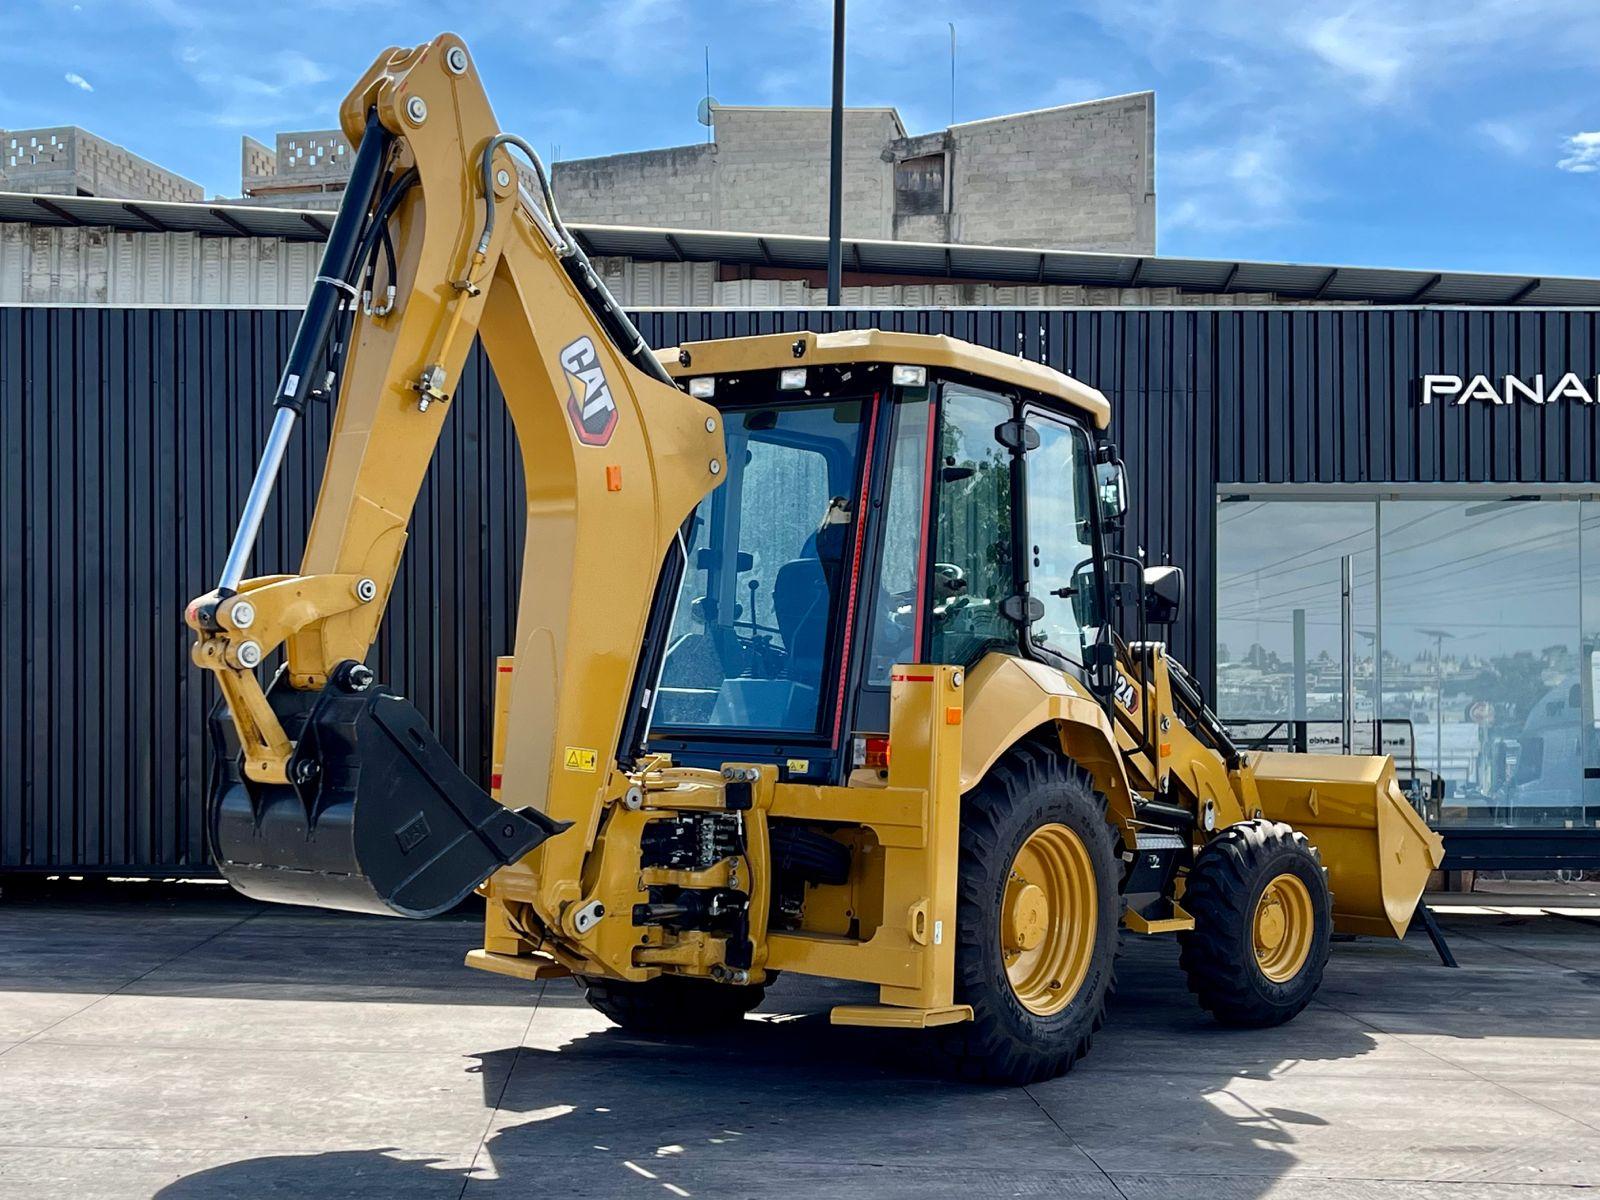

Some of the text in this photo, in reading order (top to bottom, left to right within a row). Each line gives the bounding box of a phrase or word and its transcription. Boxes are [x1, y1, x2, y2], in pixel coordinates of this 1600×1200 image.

[561, 336, 616, 421] CAT
[1423, 372, 1600, 405] PANA
[1115, 671, 1134, 708] 24
